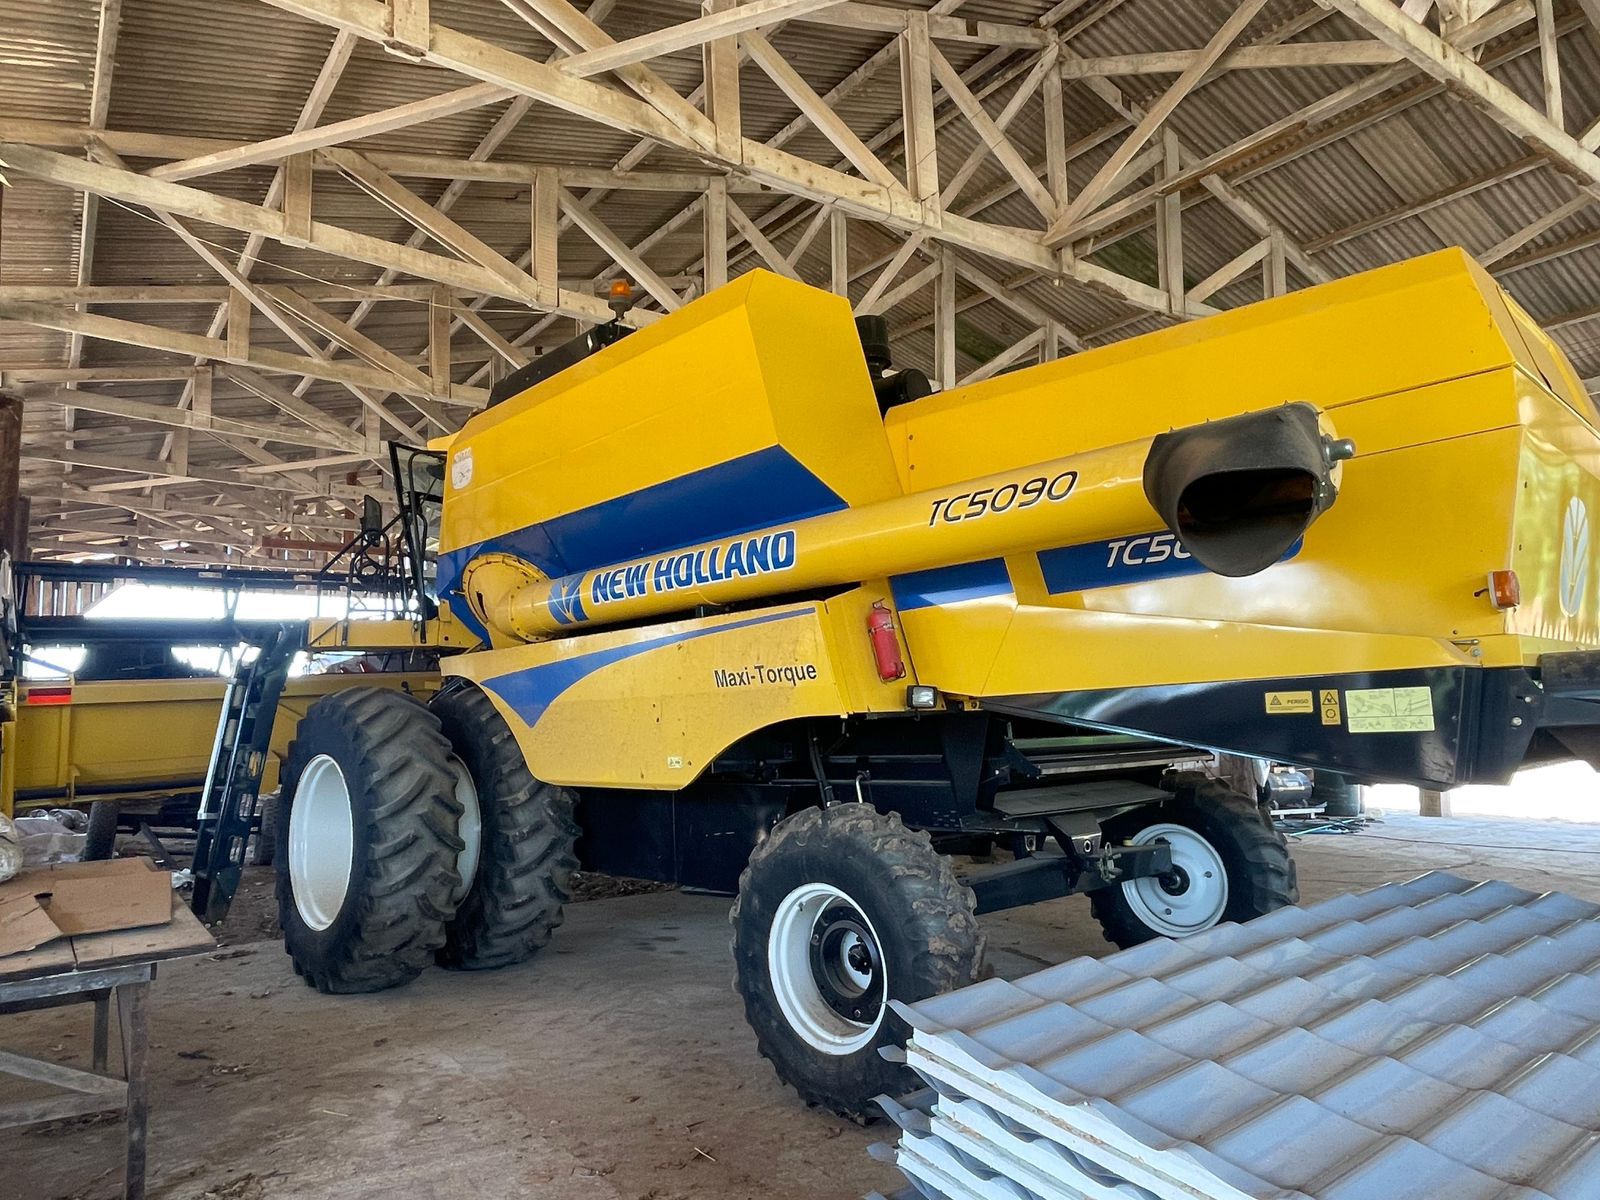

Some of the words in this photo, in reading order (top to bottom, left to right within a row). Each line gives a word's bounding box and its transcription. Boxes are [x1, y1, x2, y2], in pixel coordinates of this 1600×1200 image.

[928, 470, 1079, 527] TC5090
[591, 561, 651, 604] NEW
[653, 529, 796, 592] HOLLAND
[713, 664, 817, 688] Maxi-Torque
